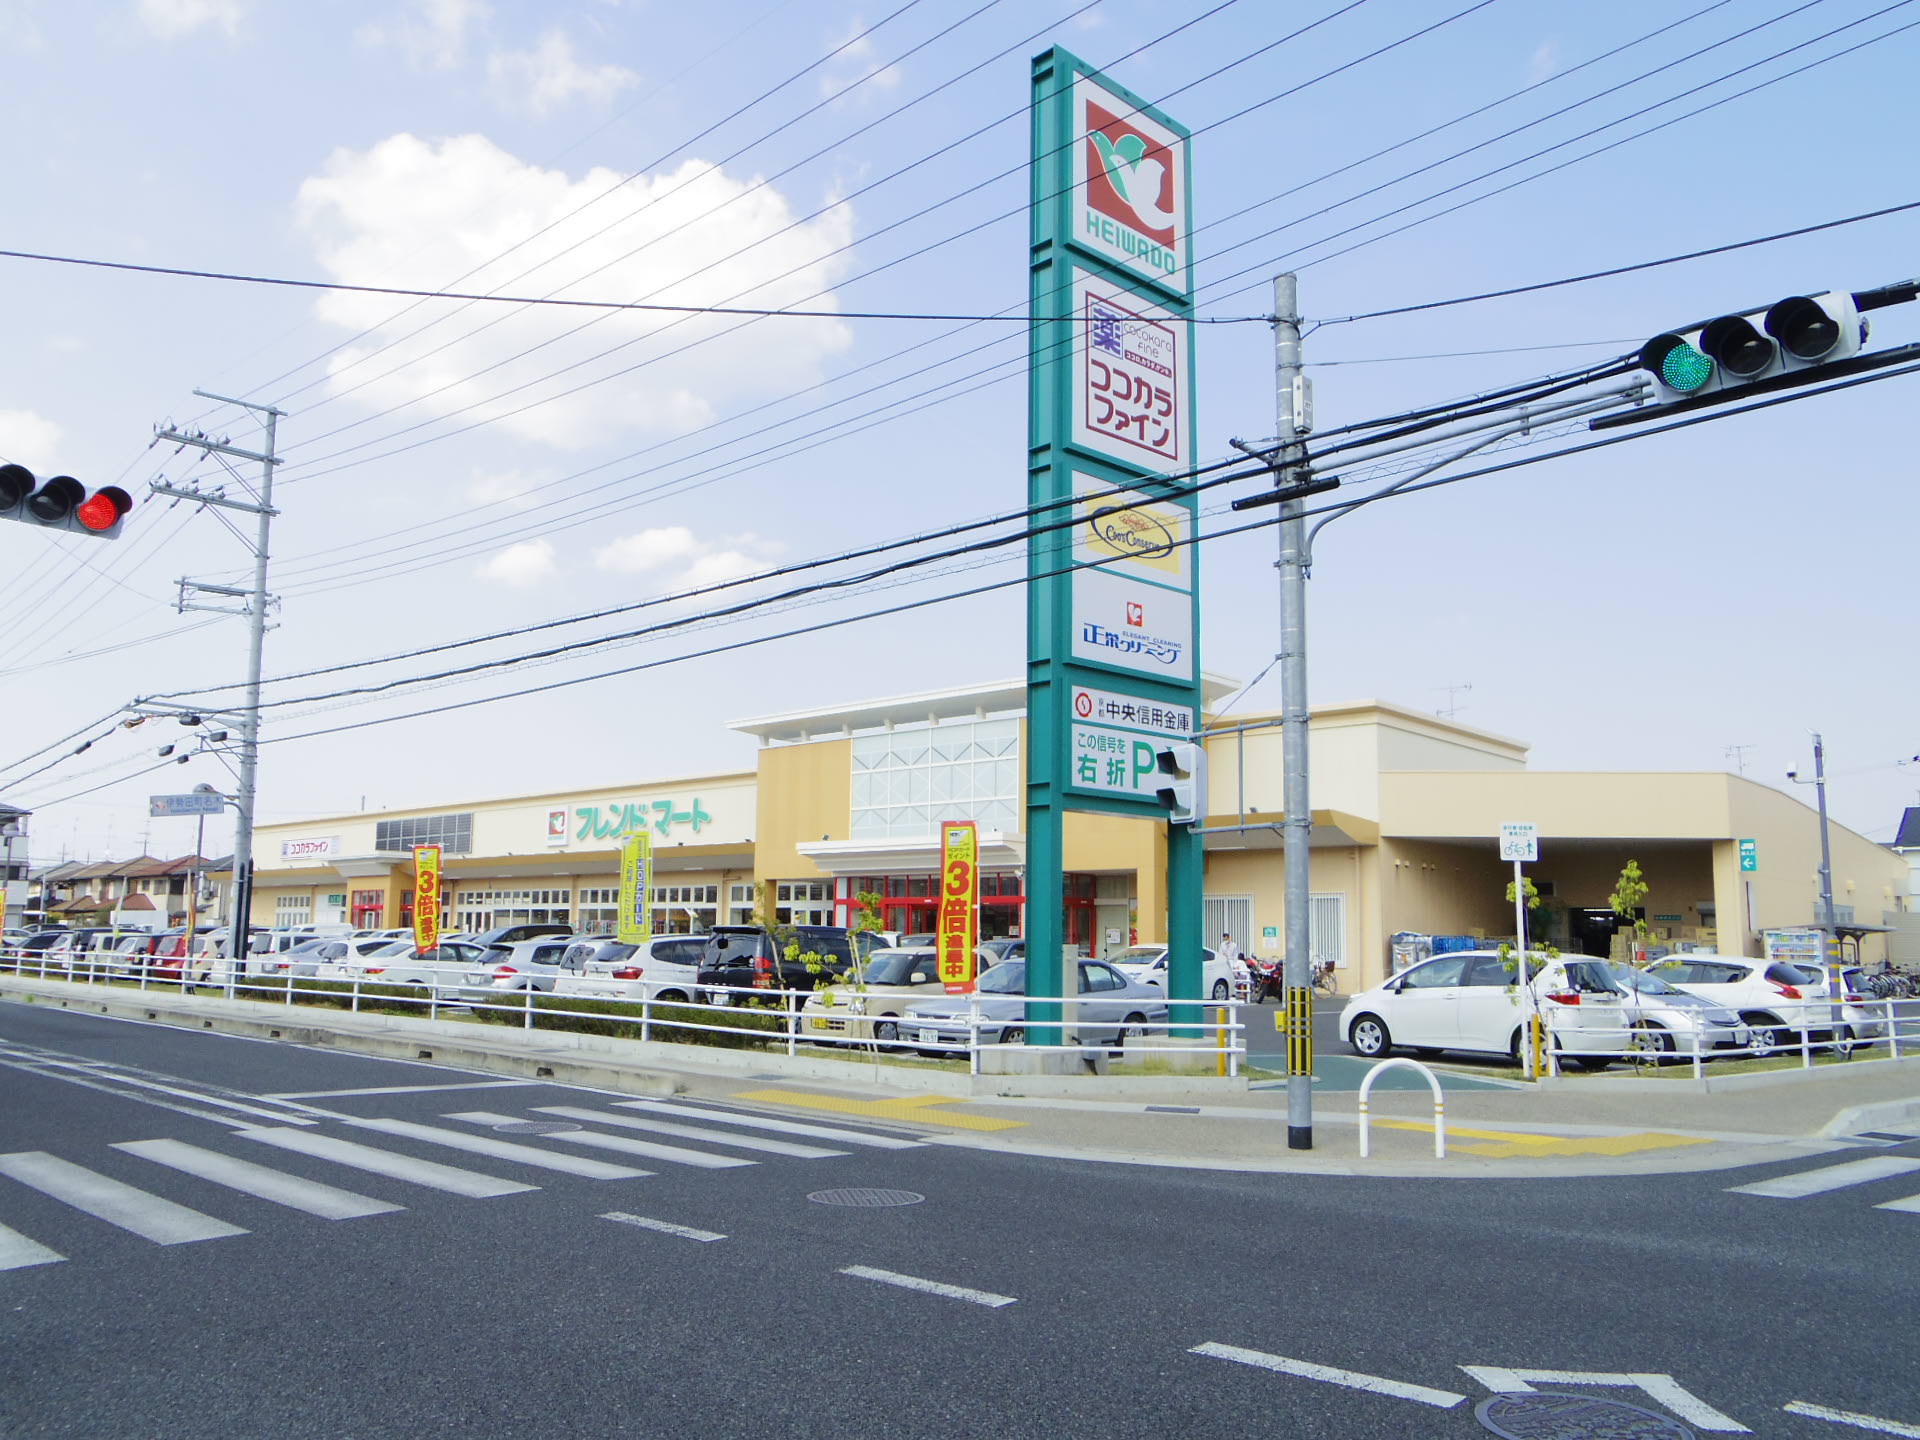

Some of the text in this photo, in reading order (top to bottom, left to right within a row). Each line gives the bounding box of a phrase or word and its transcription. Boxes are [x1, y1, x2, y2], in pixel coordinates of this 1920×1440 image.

[1086, 210, 1176, 275] HEIWADO
[1093, 307, 1121, 355] 薬
[1137, 342, 1160, 359] fine
[1091, 358, 1173, 418] ココカラ
[1094, 393, 1170, 448] ファイン
[1122, 630, 1182, 649] ELEGANT CLEANING
[1106, 700, 1190, 732] 中央信用金庫
[1078, 732, 1126, 755] この信号を
[1132, 740, 1156, 790] P
[1077, 753, 1126, 788] 右折
[576, 798, 710, 839] フレンドマート
[418, 870, 434, 942] 3倍中
